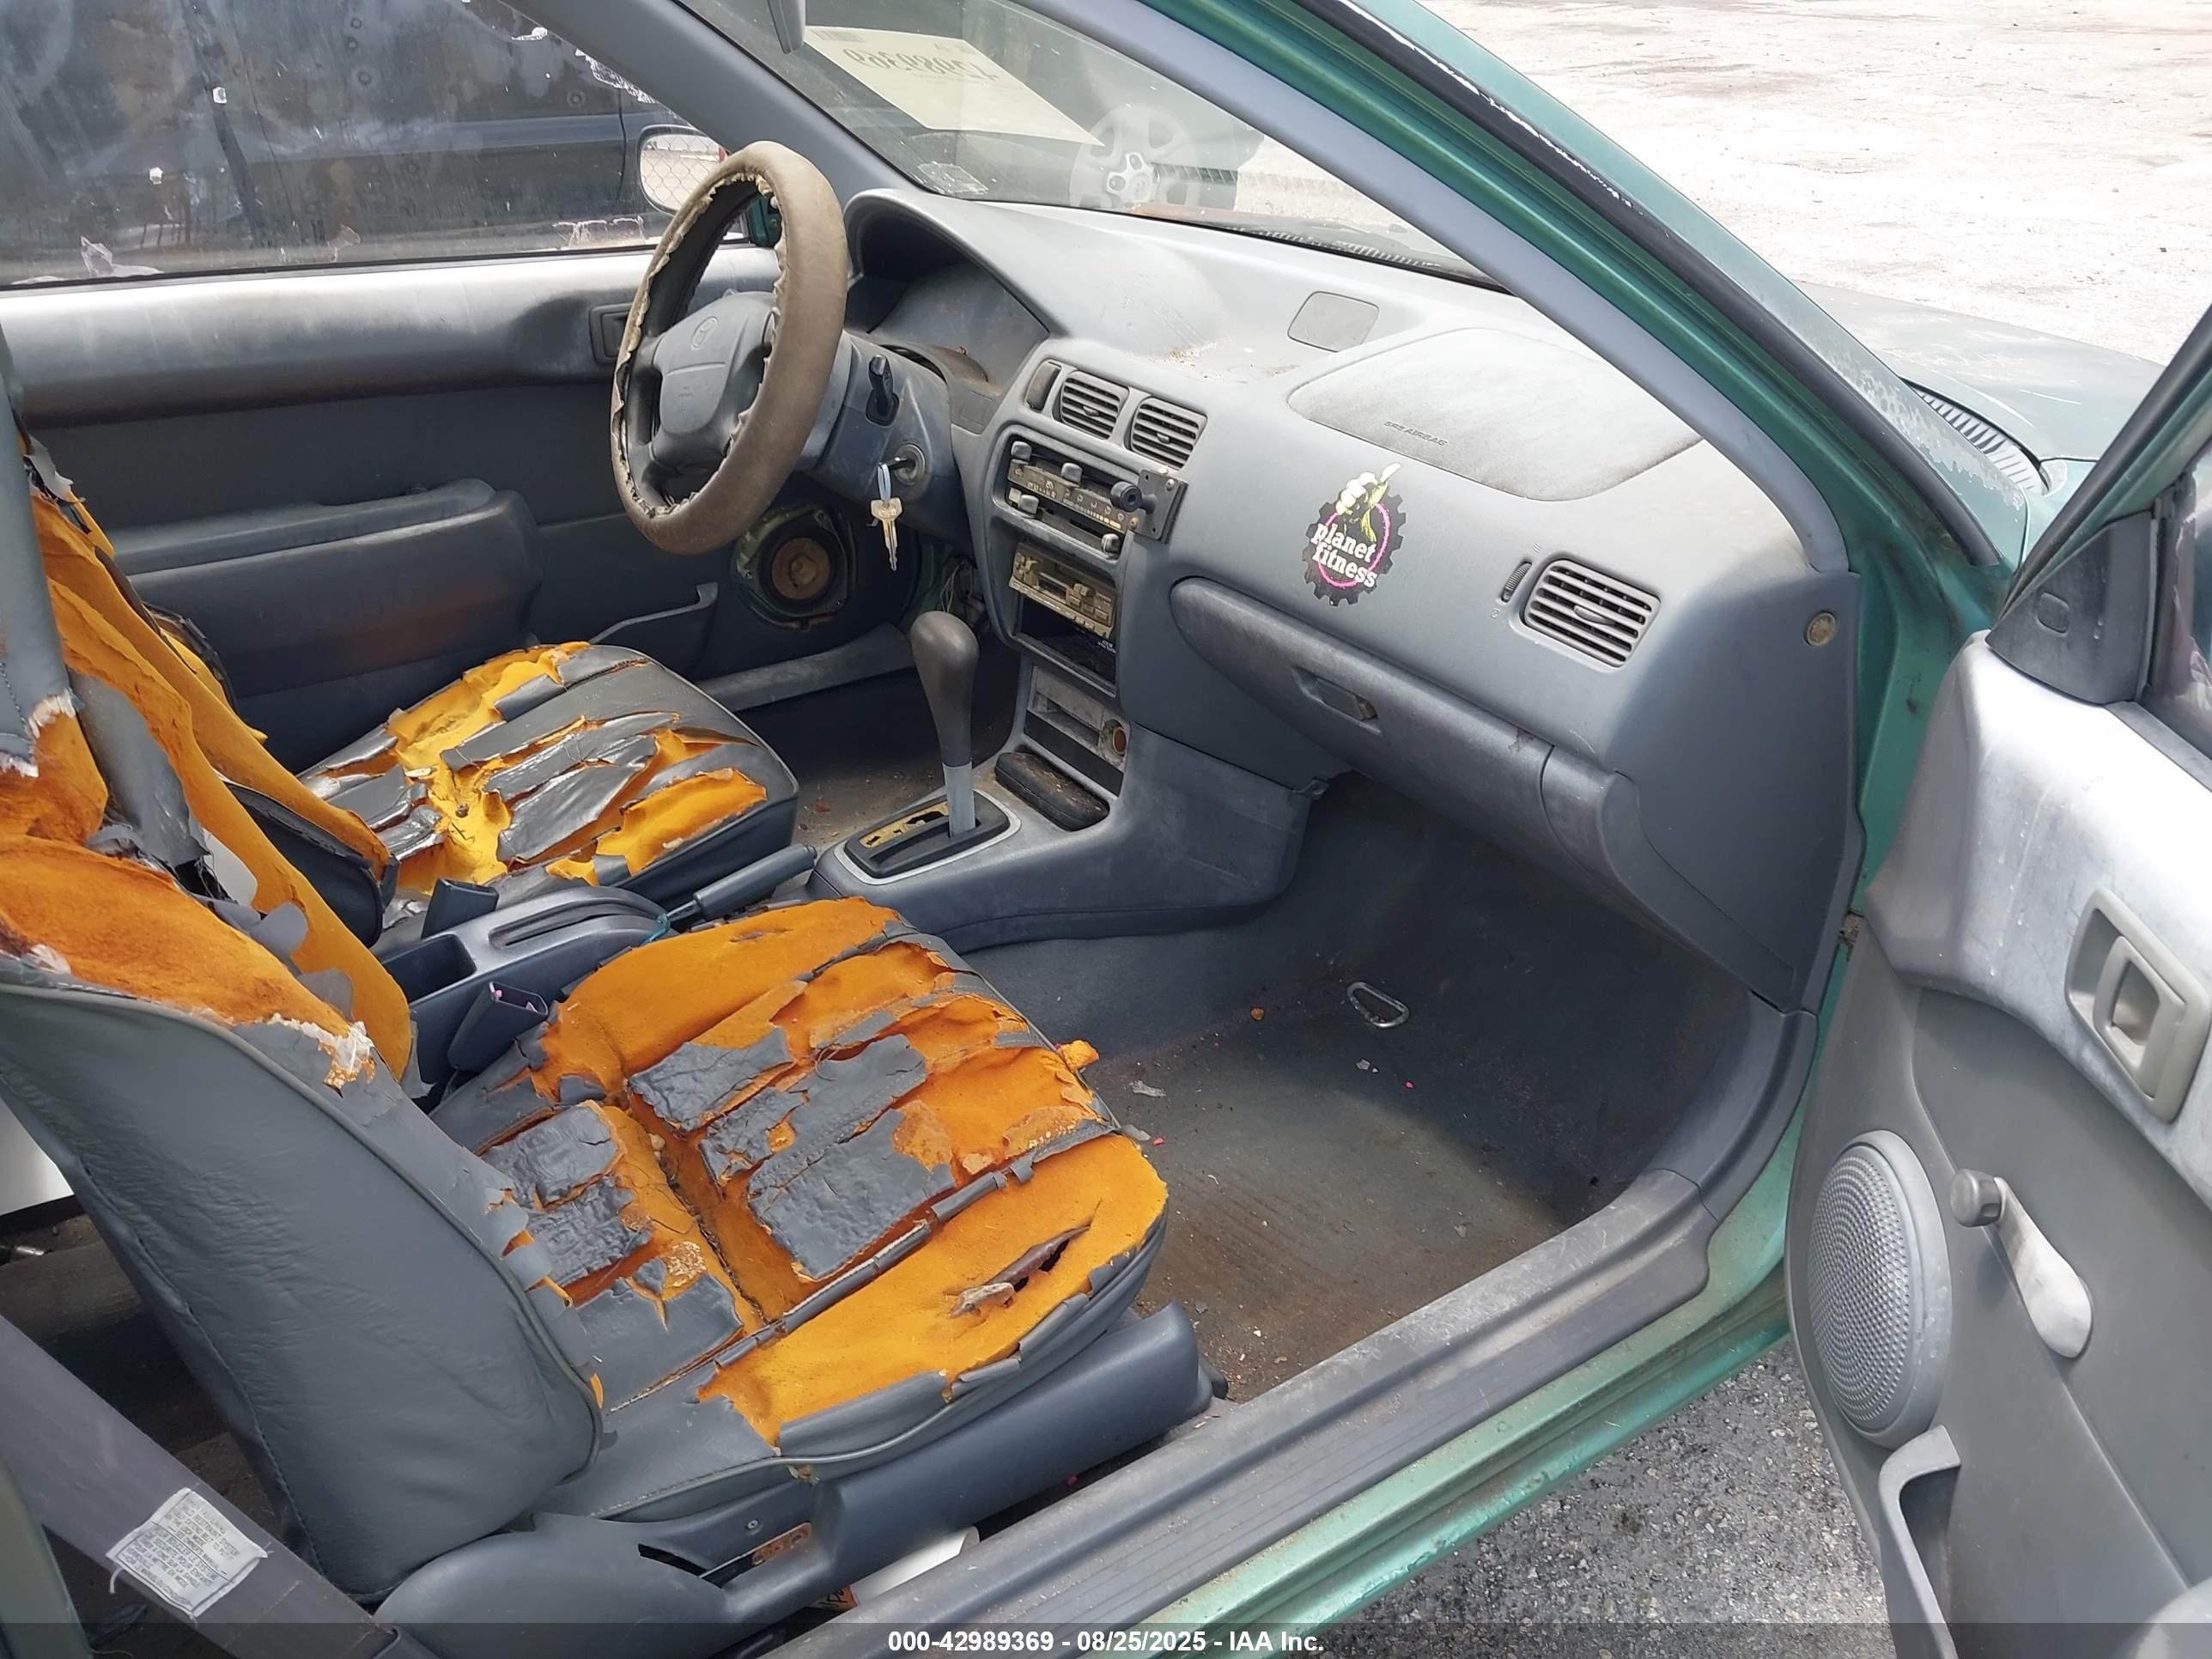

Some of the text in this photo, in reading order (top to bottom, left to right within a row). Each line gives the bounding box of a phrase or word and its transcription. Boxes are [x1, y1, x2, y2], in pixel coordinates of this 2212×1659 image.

[1403, 428, 1448, 446] AIRBAG
[1310, 523, 1376, 562] planet
[1312, 542, 1377, 587] fitness
